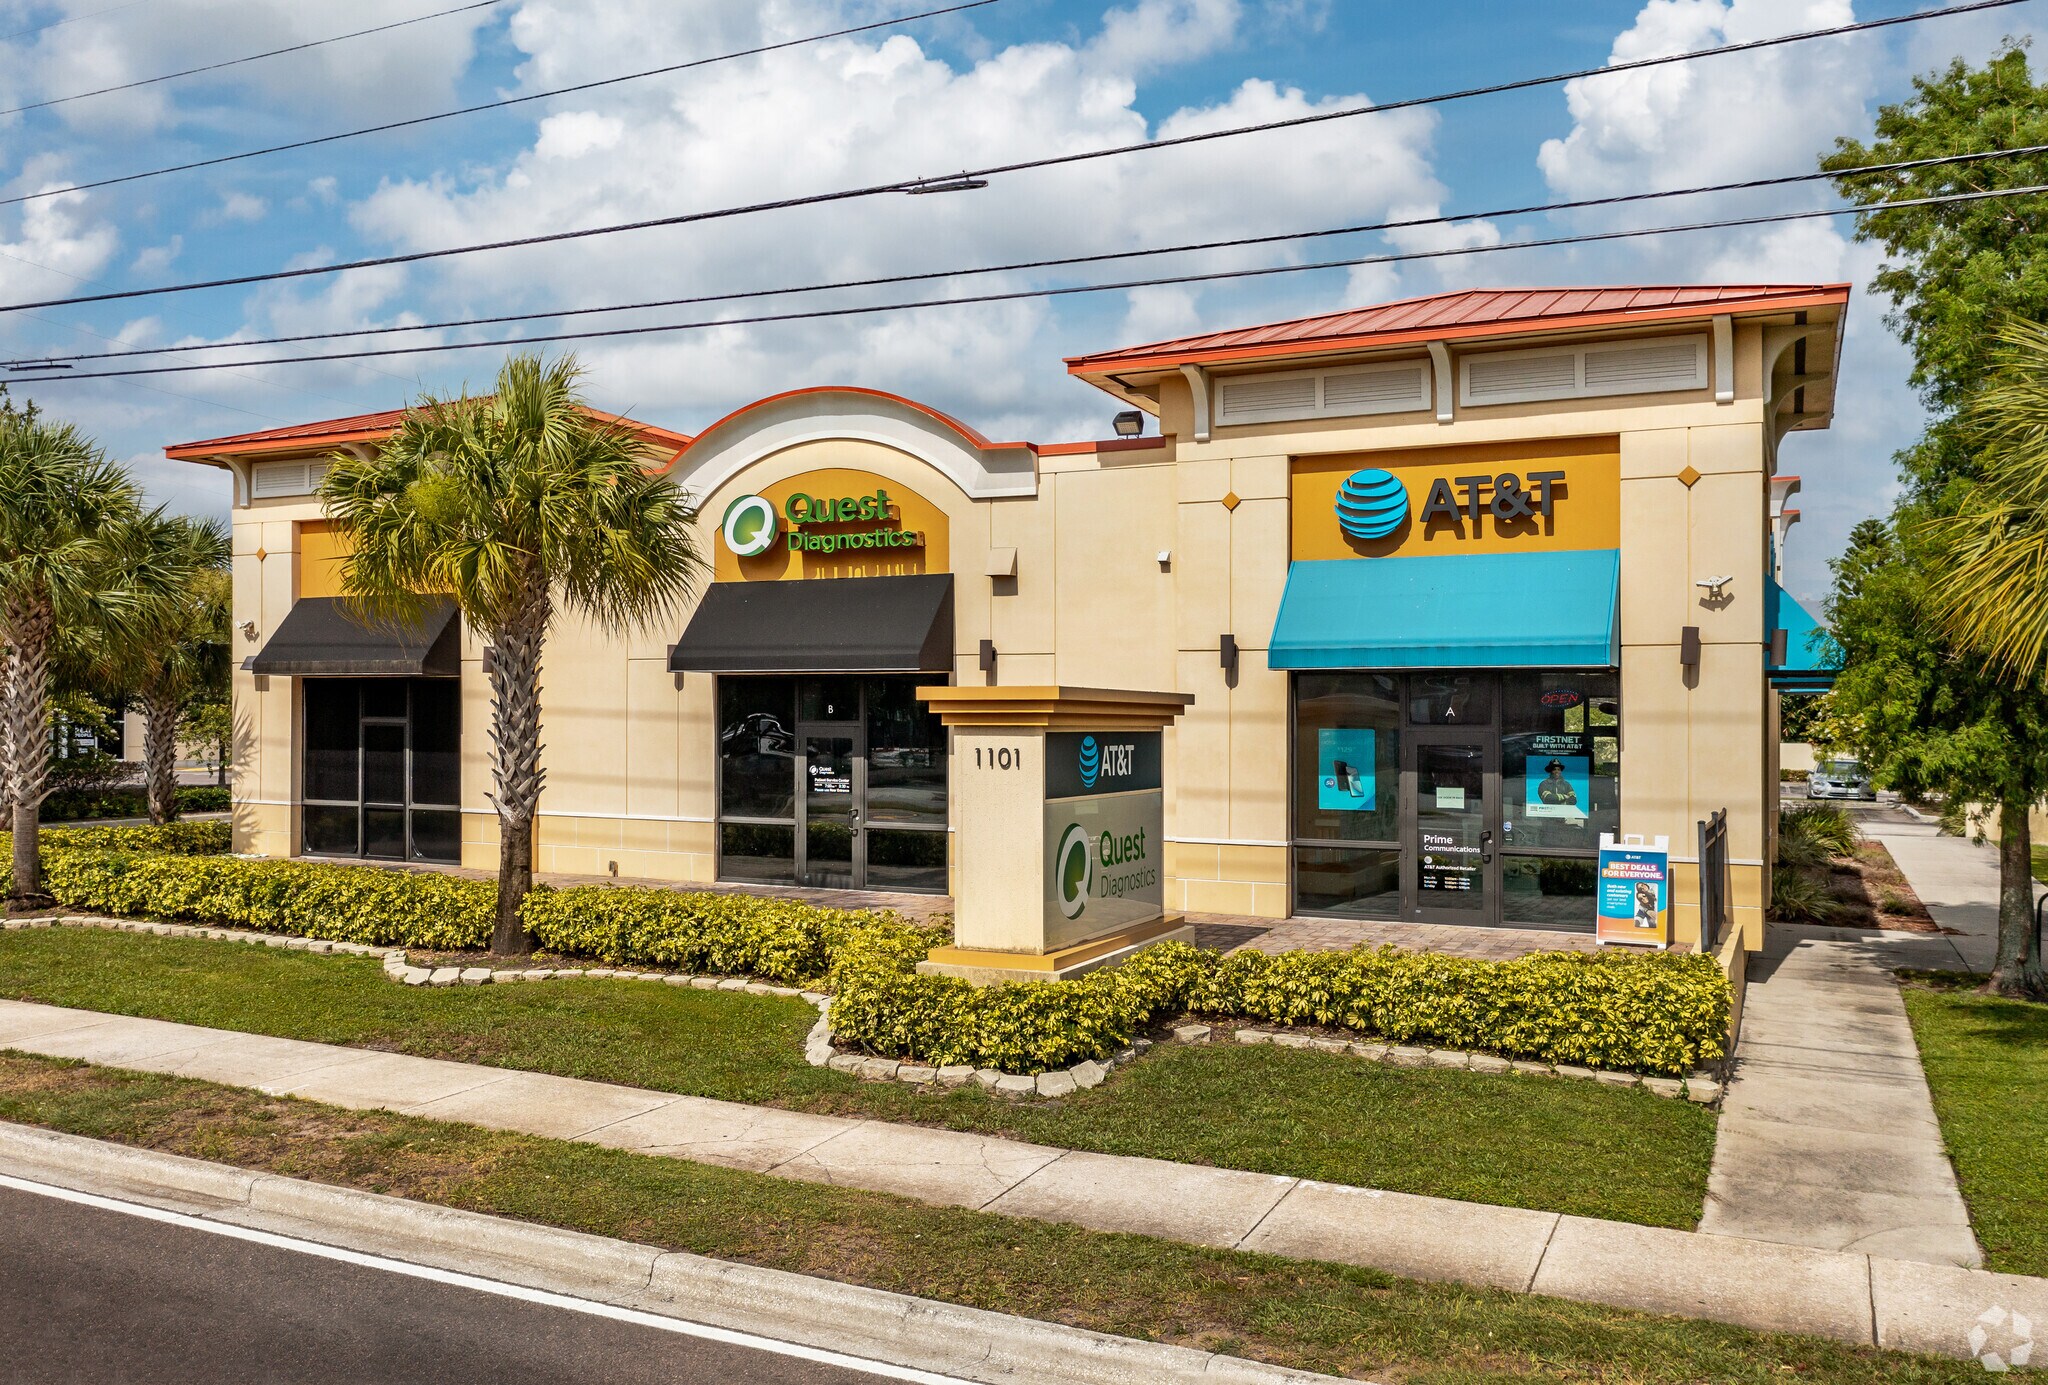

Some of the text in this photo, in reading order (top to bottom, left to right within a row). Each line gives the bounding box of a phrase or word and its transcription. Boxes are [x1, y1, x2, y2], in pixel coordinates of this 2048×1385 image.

[785, 489, 889, 524] Quest
[1420, 470, 1565, 522] AT&T
[787, 528, 914, 553] Diagnostics
[828, 705, 834, 714] B
[1541, 694, 1580, 704] OPEN
[1446, 707, 1455, 716] A
[1536, 736, 1580, 744] FIRSTNET
[974, 748, 1020, 770] 1101
[1101, 745, 1134, 777] AT&T
[1100, 826, 1146, 868] Quest
[1424, 835, 1453, 844] Prime
[1424, 845, 1480, 853] Communications
[1101, 866, 1156, 898] Diagnostics
